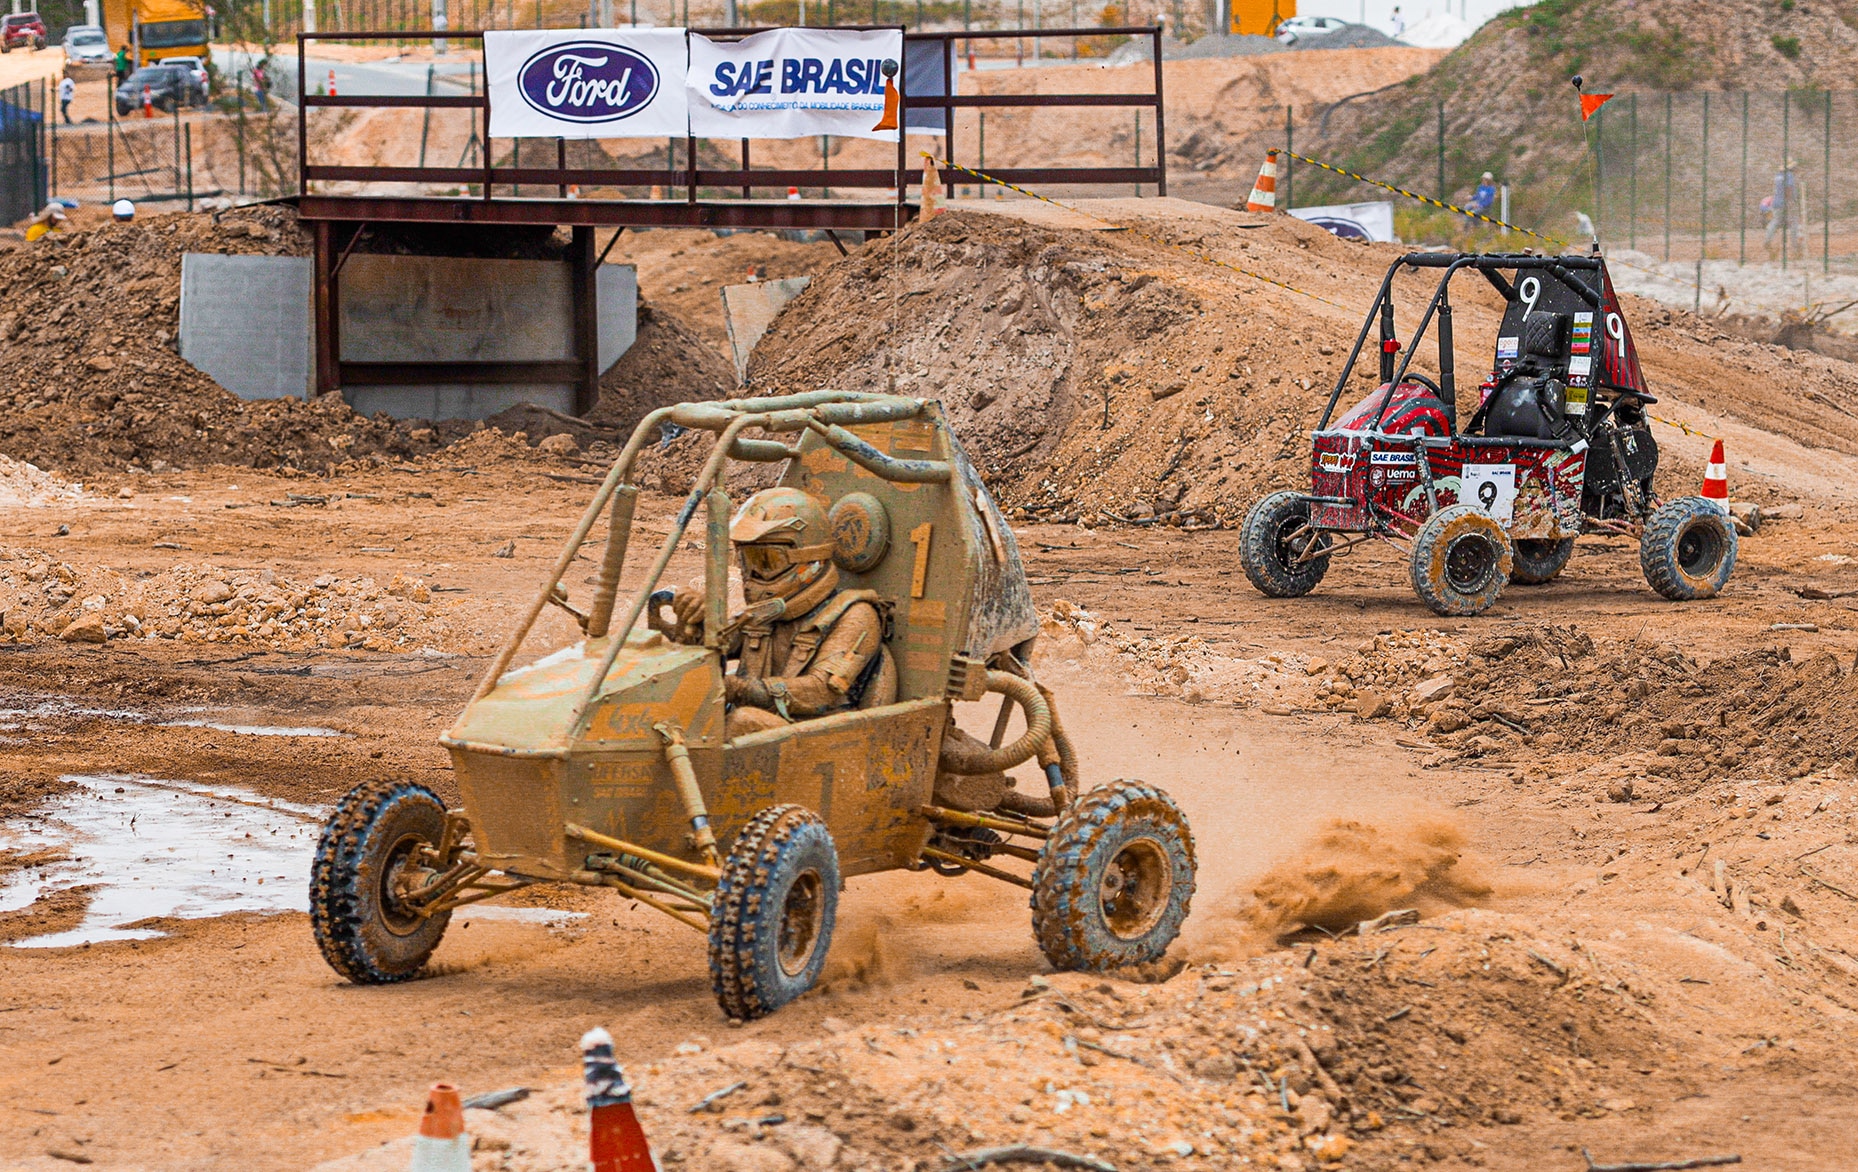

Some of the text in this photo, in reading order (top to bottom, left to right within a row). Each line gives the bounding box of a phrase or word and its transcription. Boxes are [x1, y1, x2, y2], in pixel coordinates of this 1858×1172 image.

[546, 54, 632, 107] Ford
[709, 58, 887, 97] SAE BRASIL
[1519, 276, 1541, 323] 9
[1605, 312, 1625, 358] 9
[1372, 453, 1416, 463] SAE BRASIL
[1386, 469, 1416, 479] Uema
[1478, 480, 1498, 512] 9
[910, 521, 933, 599] 1
[812, 761, 835, 820] 1
